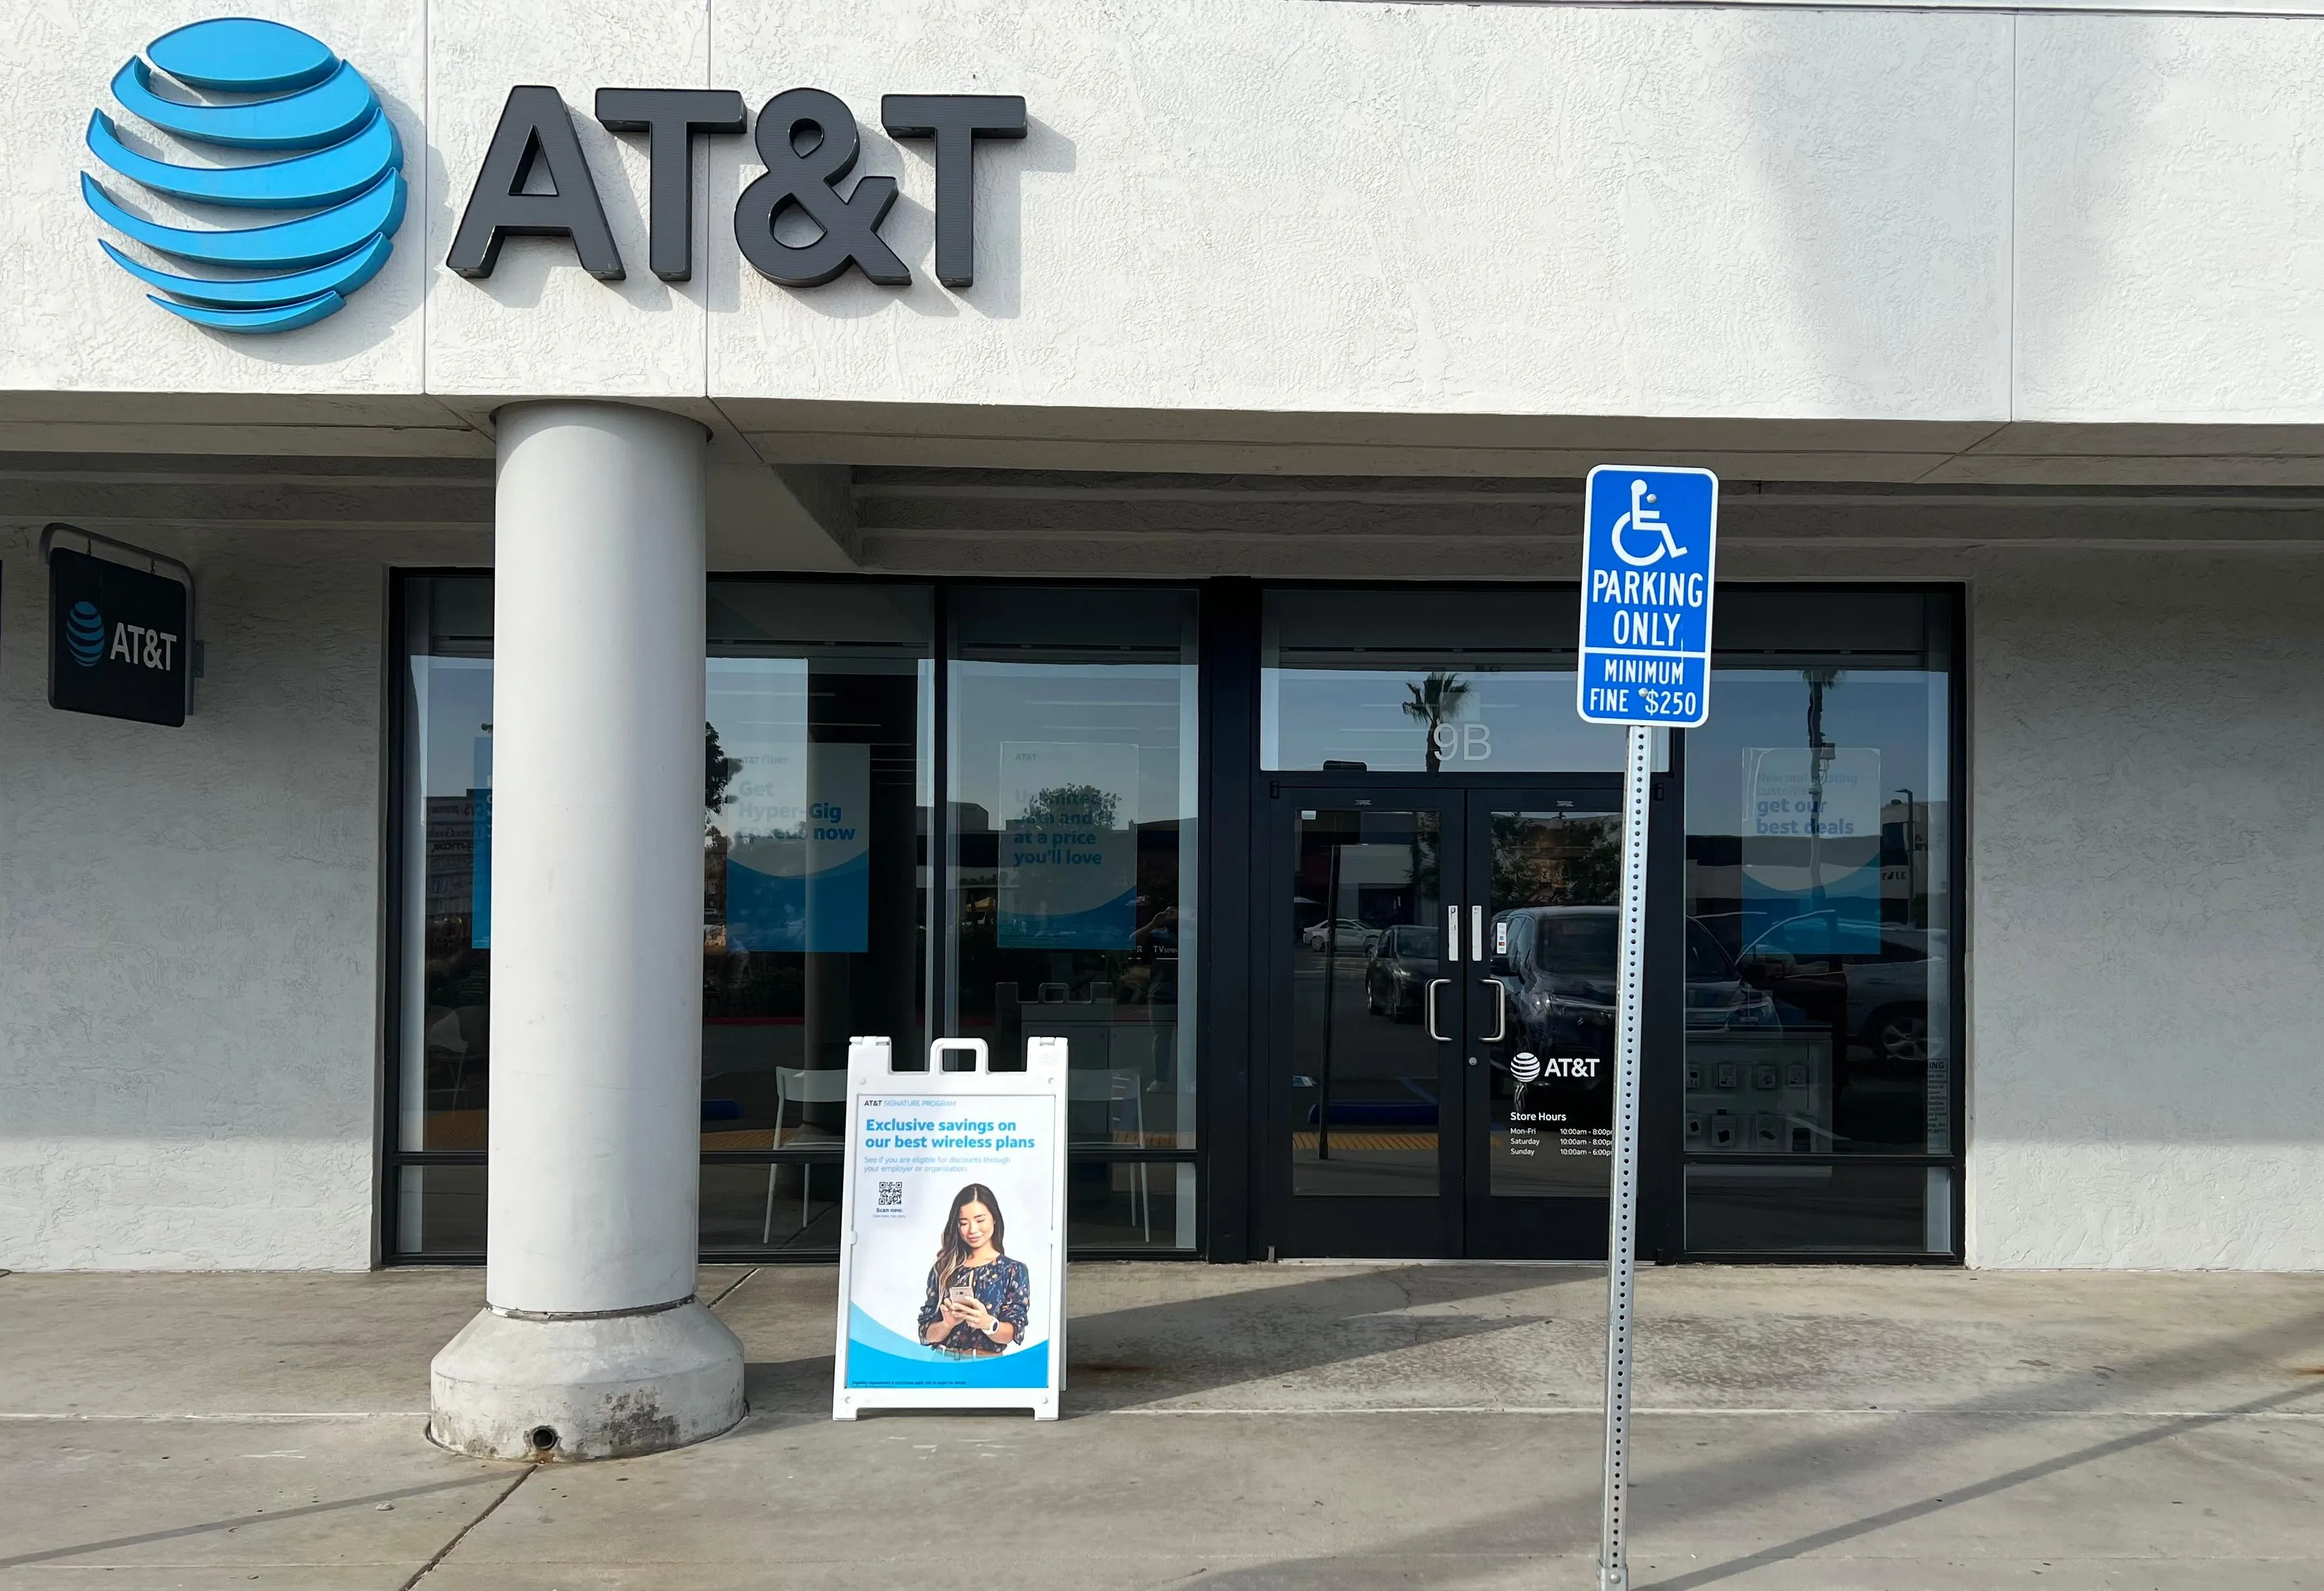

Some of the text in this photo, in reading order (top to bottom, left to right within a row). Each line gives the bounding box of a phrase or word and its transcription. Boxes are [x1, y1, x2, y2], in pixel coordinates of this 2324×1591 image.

[445, 85, 1027, 288] AT&T
[1592, 569, 1703, 608] PARKING
[1613, 610, 1681, 646] ONLY
[110, 622, 176, 671] AT&T
[1605, 659, 1683, 685] MINIMUM
[1590, 688, 1696, 716] FINE $250
[1433, 723, 1492, 760] 9B
[739, 781, 774, 797] Get
[1757, 799, 1827, 816] get our
[814, 827, 855, 840] now
[1757, 818, 1854, 834] best deals
[1014, 831, 1096, 850] at a price
[1014, 850, 1102, 867] you'll love
[1544, 1058, 1599, 1077] AT&T
[1510, 1112, 1566, 1121] Store Hours
[866, 1118, 1016, 1134] Exclusive savings on
[1592, 1128, 1612, 1137] 8:00p
[865, 1135, 1035, 1151] our best wireless plans
[1510, 1137, 1540, 1146] Saturday
[912, 1156, 936, 1165] eligible
[984, 1156, 1011, 1165] through
[1510, 1148, 1535, 1156] Sunday
